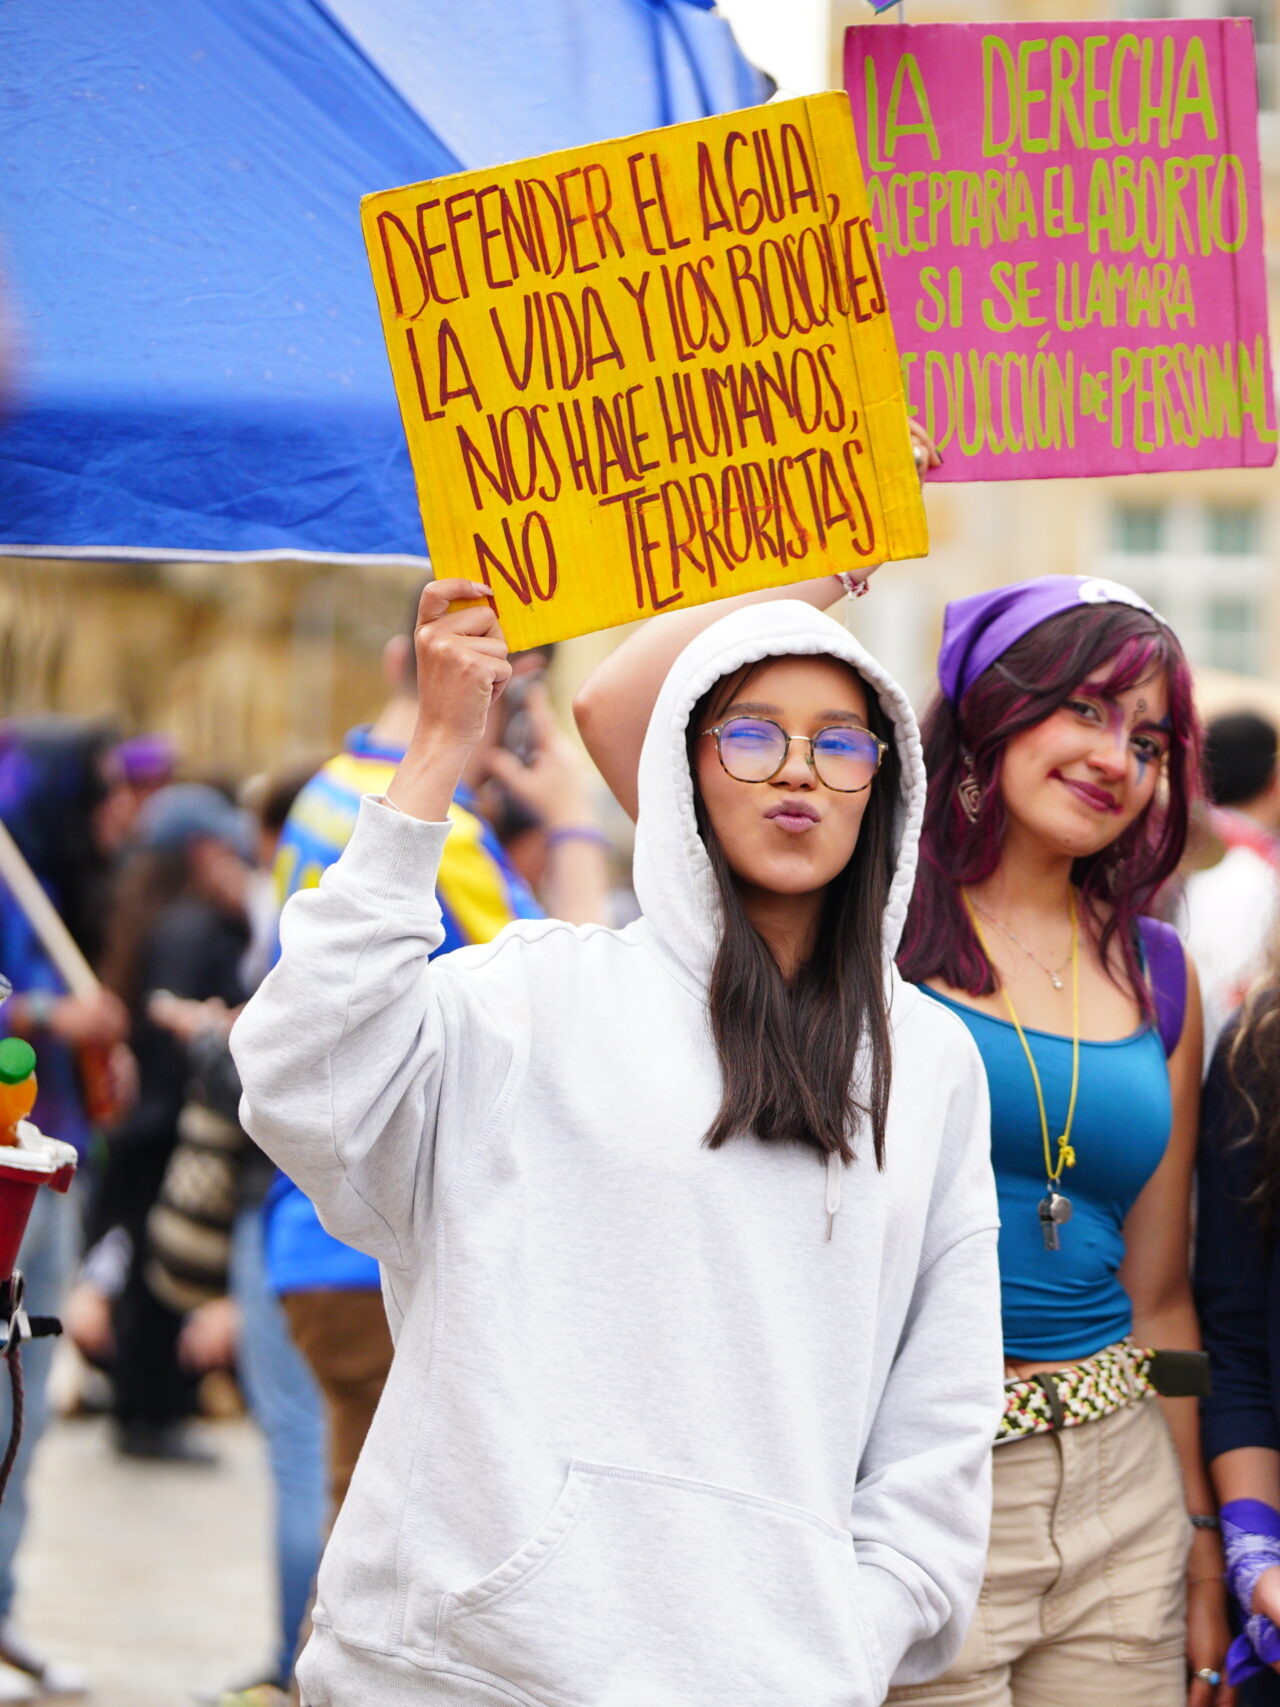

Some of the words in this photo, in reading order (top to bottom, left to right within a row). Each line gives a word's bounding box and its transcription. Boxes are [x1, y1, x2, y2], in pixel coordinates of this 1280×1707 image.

[864, 54, 940, 171] LA
[982, 33, 1218, 158] DERECHA
[376, 164, 625, 321] DEFENDER
[628, 152, 690, 256] EL
[697, 123, 841, 241] AGUA,
[1044, 164, 1085, 238] EL
[1089, 154, 1249, 259] ABORTO
[406, 317, 484, 422] LA
[489, 286, 626, 391] VIDA
[618, 270, 655, 363] Y
[660, 255, 732, 363] LOS
[728, 216, 888, 349] BOSQUES
[916, 266, 962, 332] SI
[981, 261, 1049, 332] SE
[1056, 261, 1196, 330] LLAMARA
[456, 403, 562, 510] NOS
[557, 383, 662, 495] HACE
[654, 343, 860, 464] HUMANOS,
[901, 332, 1075, 456] EDUCCIÓN
[1111, 333, 1280, 454] PERSONAL
[472, 510, 558, 617] NO
[600, 438, 876, 611] TERRORISTAS
